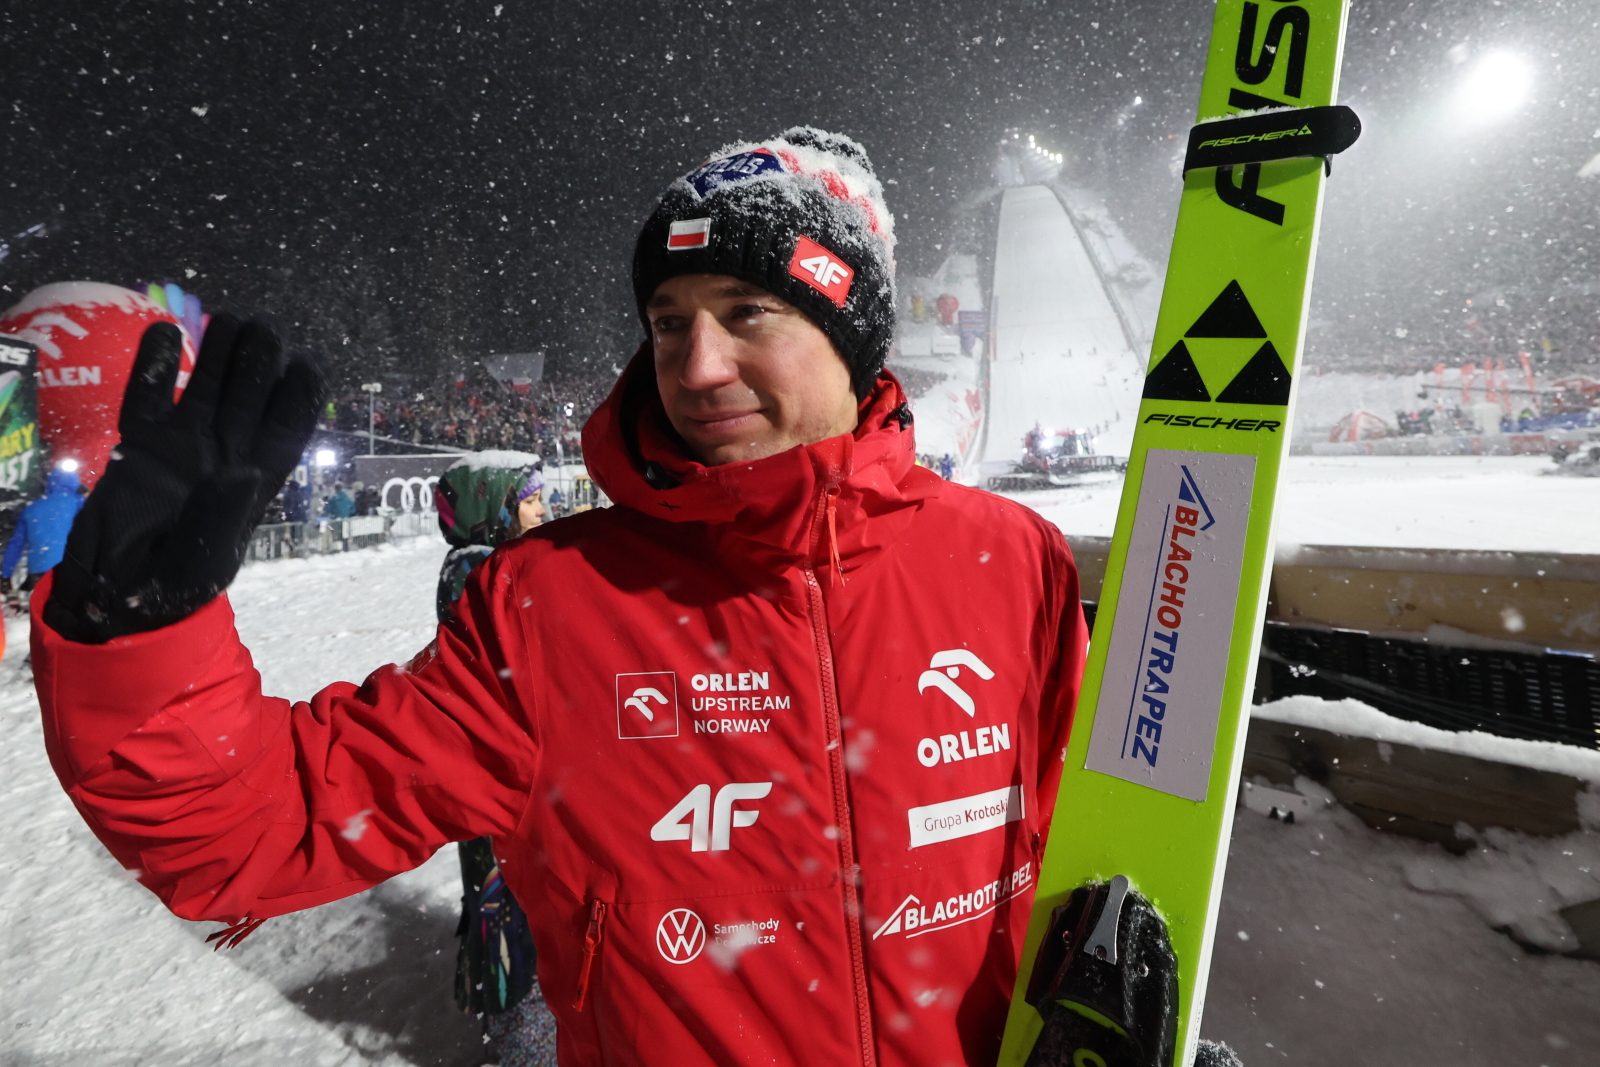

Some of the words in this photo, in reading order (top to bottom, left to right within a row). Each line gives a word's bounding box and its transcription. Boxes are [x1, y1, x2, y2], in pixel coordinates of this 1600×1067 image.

[1198, 128, 1299, 149] FISCHER
[800, 255, 848, 288] 4F
[1143, 413, 1281, 433] FISCHER
[1131, 504, 1200, 768] BLACHOTRAPEZ
[691, 671, 769, 692] ORLEN
[692, 696, 791, 712] UPSTREAM
[694, 718, 771, 734] NORWAY
[917, 723, 1011, 767] ORLEN
[650, 782, 773, 852] 4F
[924, 814, 962, 831] Grupa
[964, 798, 1008, 823] Krotoski
[905, 861, 1032, 930] BLACHOTRAPEZ
[714, 918, 780, 934] Samochody
